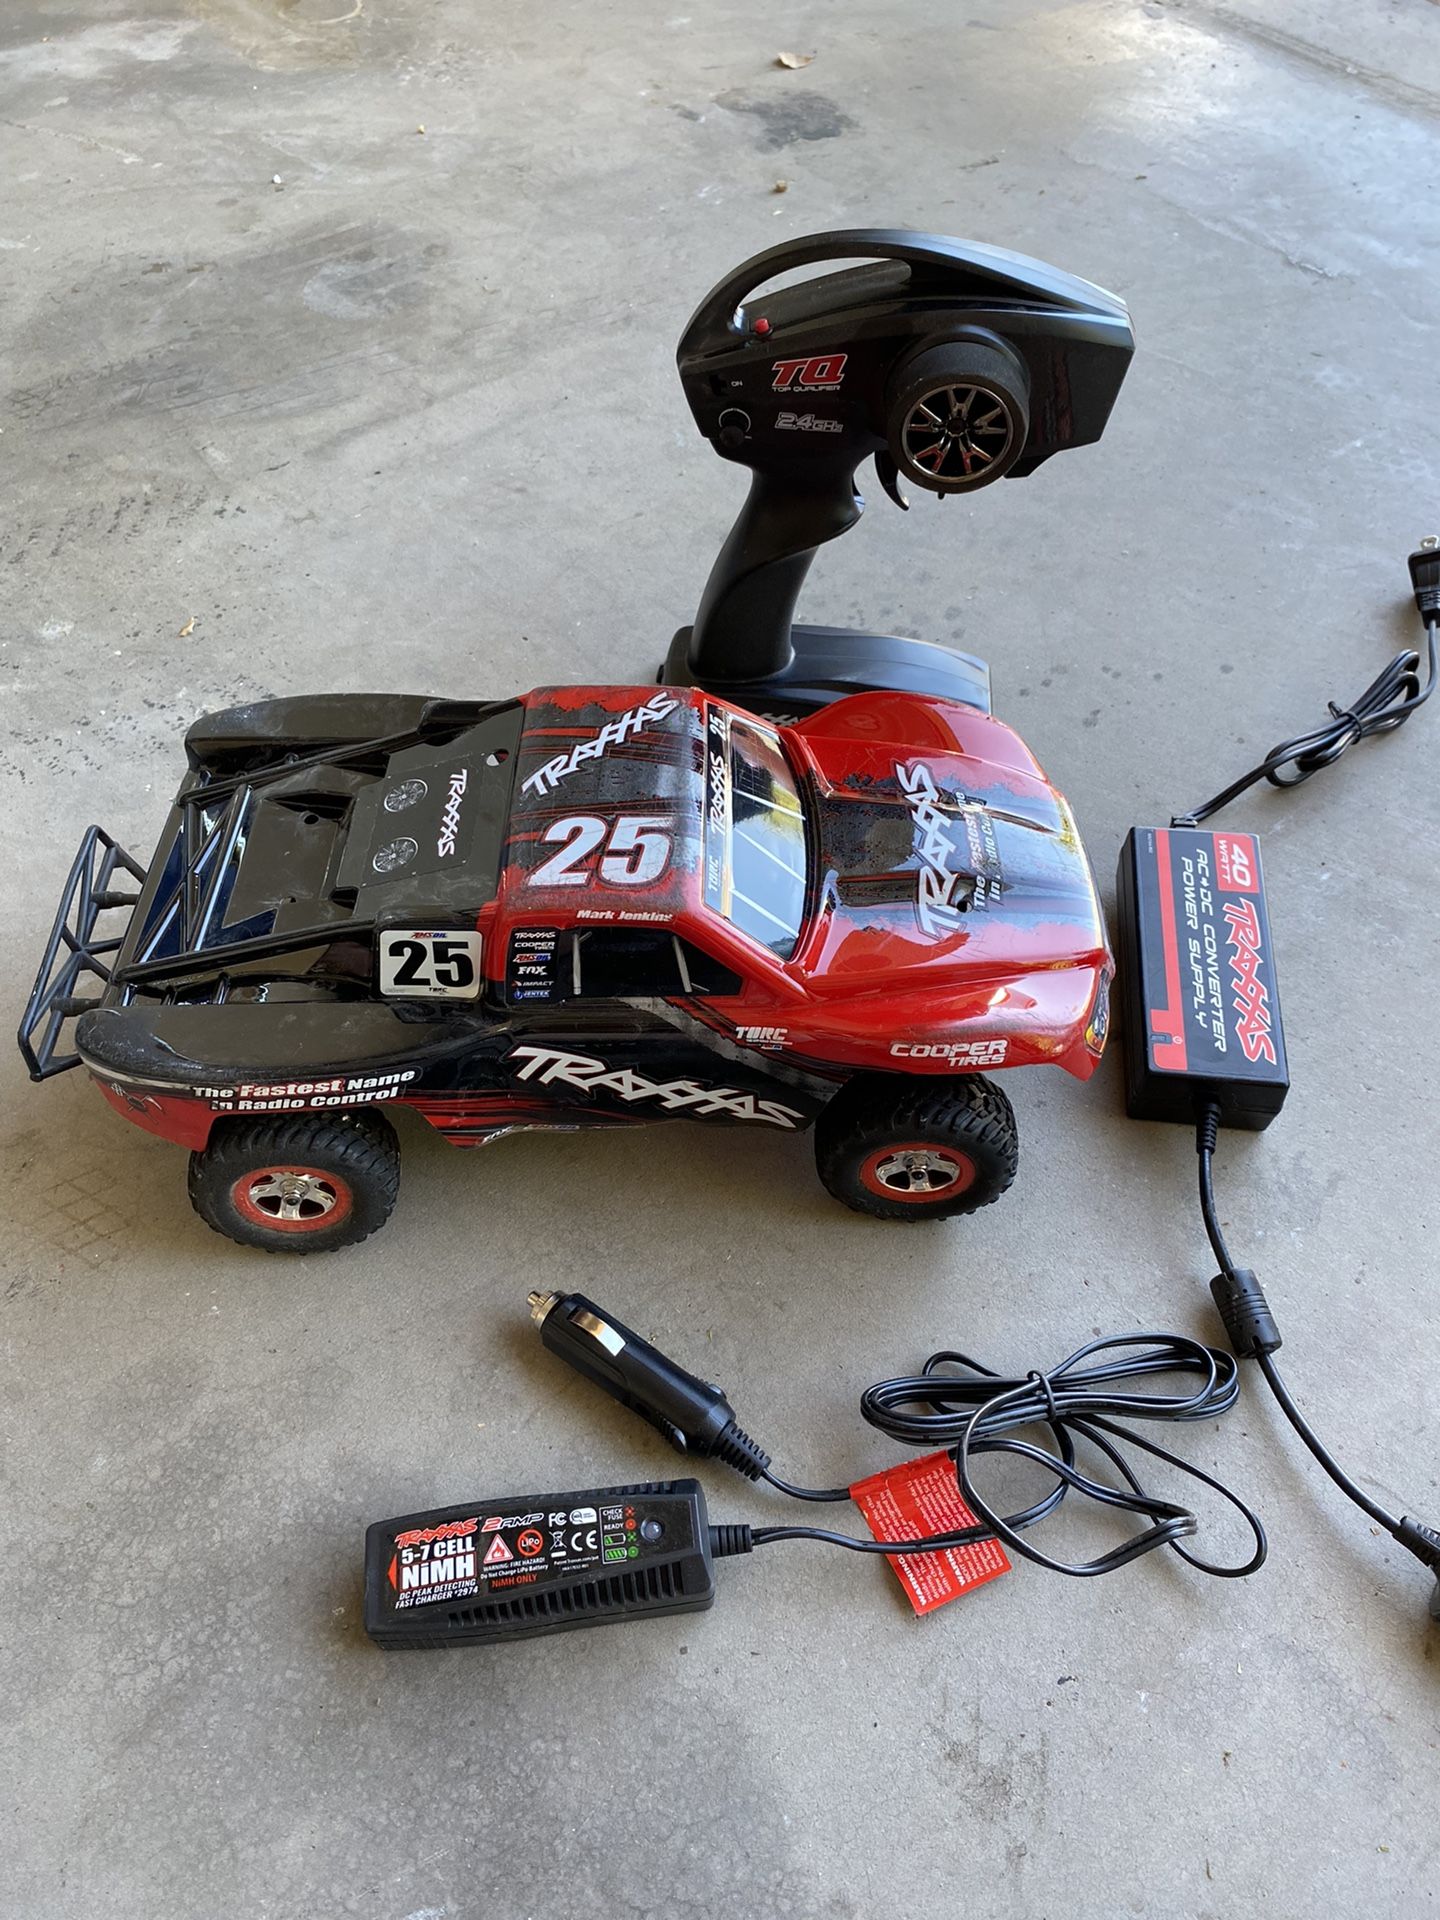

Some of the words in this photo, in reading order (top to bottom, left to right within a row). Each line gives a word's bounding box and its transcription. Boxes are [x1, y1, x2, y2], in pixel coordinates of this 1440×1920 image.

[771, 354, 848, 387] TQ
[709, 713, 727, 740] 25
[522, 692, 679, 795] TRAXXAS
[707, 751, 728, 835] TRAXXAS
[438, 769, 467, 857] TRAXXAS
[527, 816, 673, 888] 25
[1218, 839, 1230, 883] WATT
[1230, 842, 1250, 887] 40
[973, 875, 985, 906] The
[1181, 856, 1198, 929] POWER
[576, 909, 614, 919] Mark
[617, 911, 673, 921] Jenkins
[514, 931, 556, 939] TRAXXAS
[388, 940, 474, 988] 25
[1188, 937, 1207, 1028] SUPPLY
[1203, 922, 1226, 1053] CONVERTER
[1221, 895, 1276, 1068] TRAXXAS
[735, 1026, 788, 1041] TORC
[891, 1039, 1008, 1058] COOPER
[947, 1055, 1005, 1067] TIRES
[192, 1086, 234, 1099] The
[239, 1079, 343, 1098] Fastest
[346, 1069, 416, 1091] Name
[238, 1096, 306, 1111] Radio
[310, 1086, 399, 1107] Control
[510, 1046, 806, 1128] TRAXXAS
[603, 1508, 623, 1516] CHECK
[394, 1517, 478, 1549] TRAXXAS
[401, 1544, 431, 1565] 5-7
[433, 1536, 475, 1557] CELL
[510, 1559, 522, 1567] FIRE
[402, 1553, 475, 1590] NiMH
[498, 1568, 516, 1577] Charge
[529, 1563, 549, 1572] Battery
[516, 1574, 537, 1583] ONLY
[395, 1598, 415, 1609] FAST
[415, 1590, 453, 1605] CHARGER
[399, 1591, 411, 1600] DC
[412, 1586, 433, 1598] PEAK
[433, 1578, 476, 1593] DETECTING
